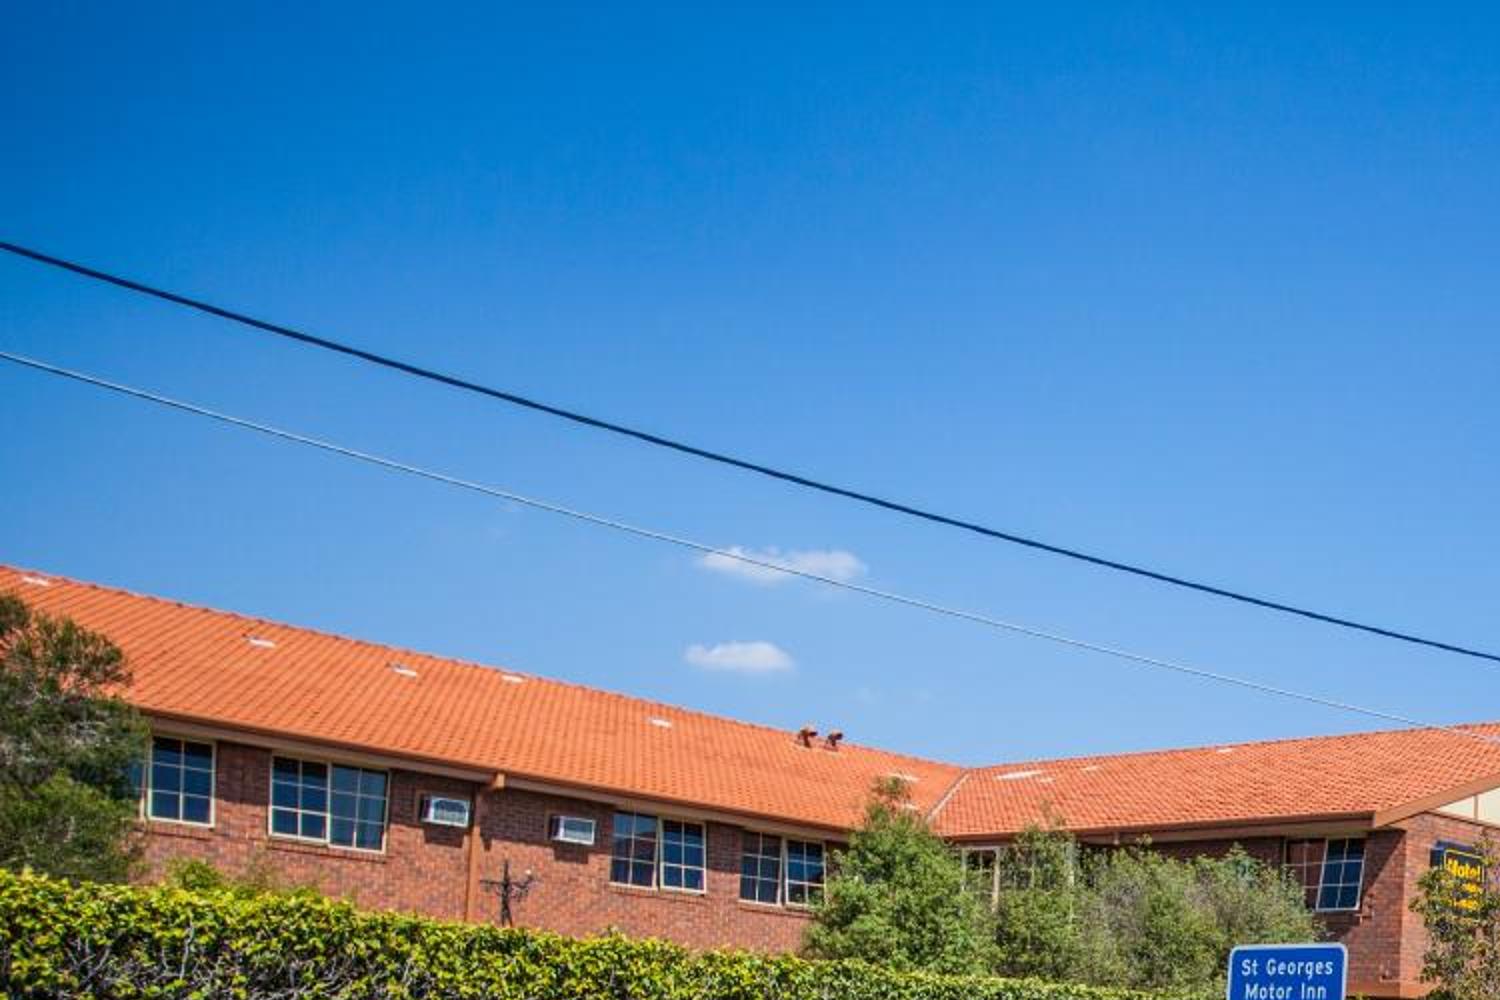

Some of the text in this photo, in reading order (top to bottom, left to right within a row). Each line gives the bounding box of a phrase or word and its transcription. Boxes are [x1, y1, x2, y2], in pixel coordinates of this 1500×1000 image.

[1241, 957, 1334, 981] St Georges
[1244, 983, 1327, 1000] Motor Inn
